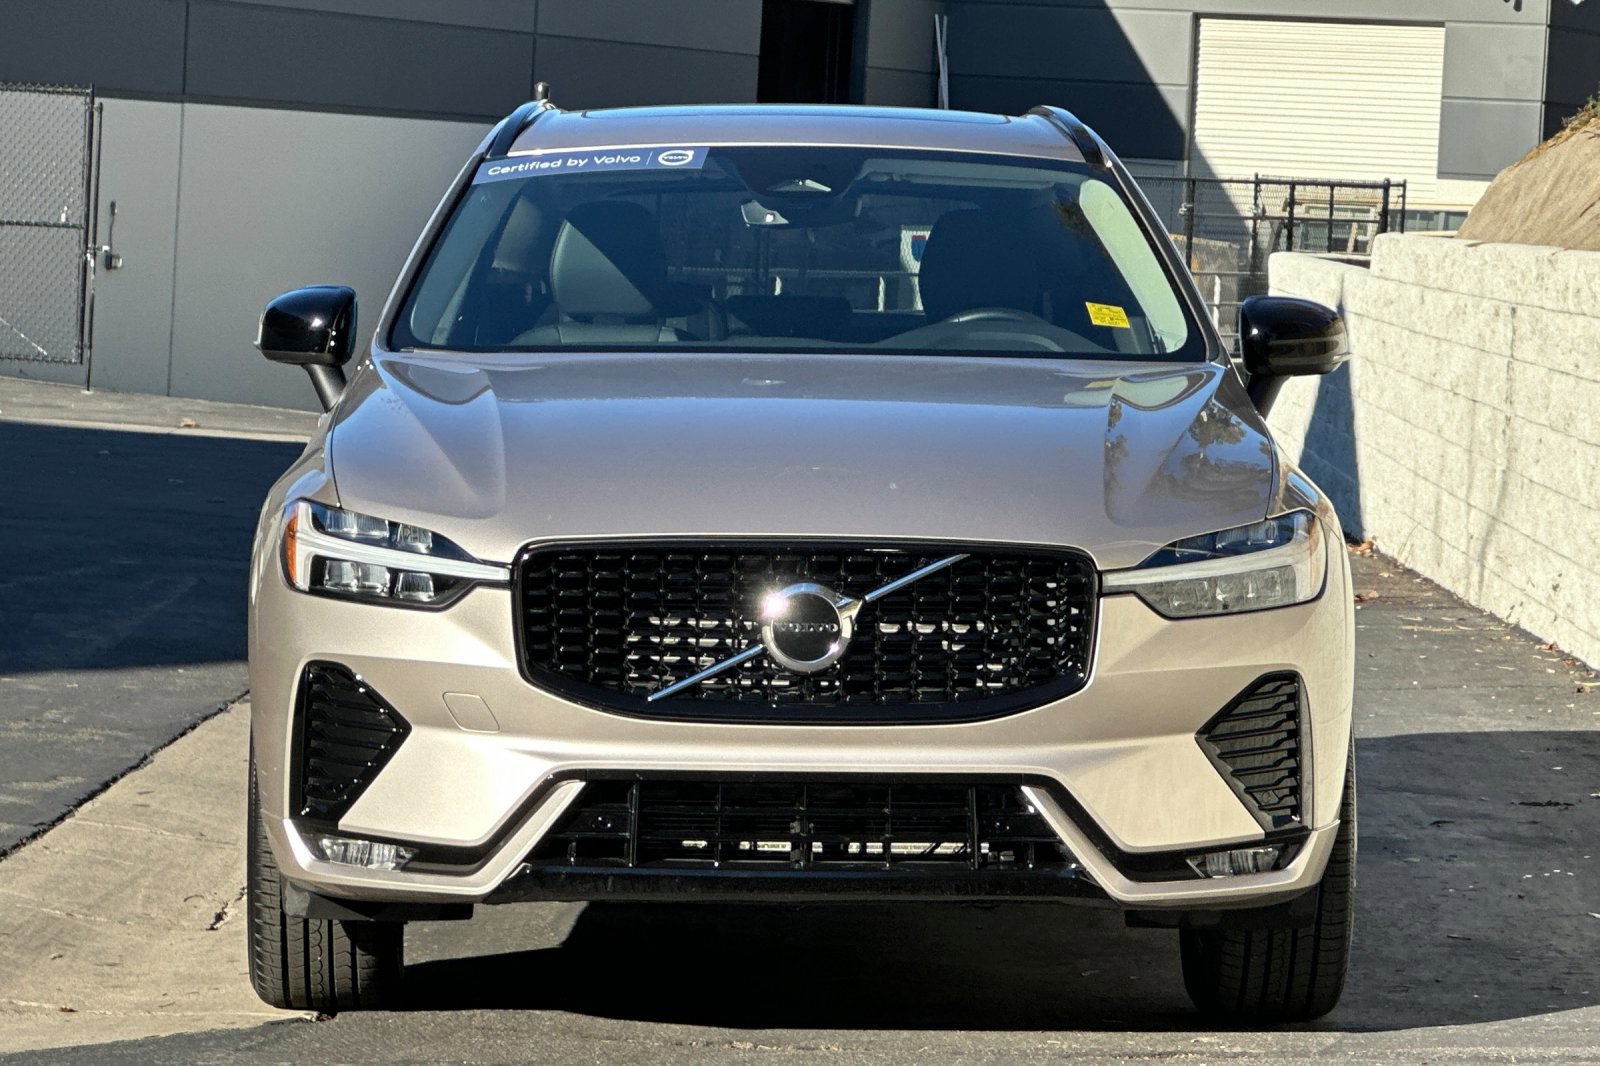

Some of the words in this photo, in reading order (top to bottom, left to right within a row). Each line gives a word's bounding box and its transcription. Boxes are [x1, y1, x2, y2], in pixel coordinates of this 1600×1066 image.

[488, 157, 562, 176] Certified
[567, 157, 588, 167] by
[594, 154, 641, 165] Volvo
[774, 622, 839, 633] VOLVO
